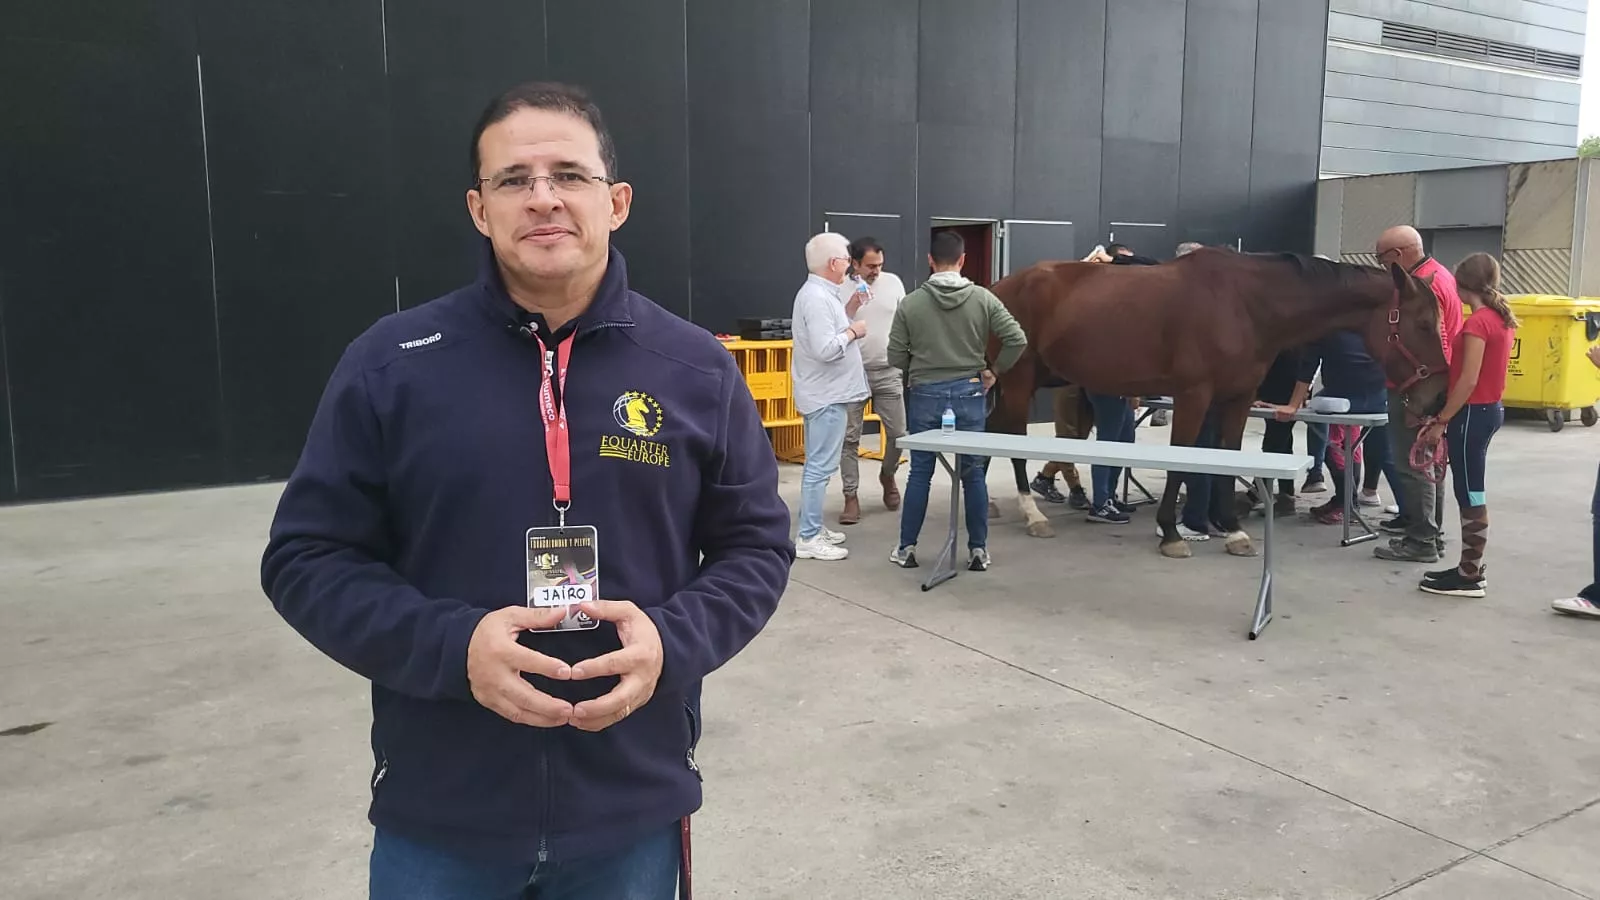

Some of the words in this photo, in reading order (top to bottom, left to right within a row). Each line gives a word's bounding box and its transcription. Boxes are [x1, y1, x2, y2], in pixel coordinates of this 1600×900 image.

[398, 332, 442, 349] TRIBORD
[601, 435, 669, 457] EQUARTER
[627, 449, 671, 468] EUROPE
